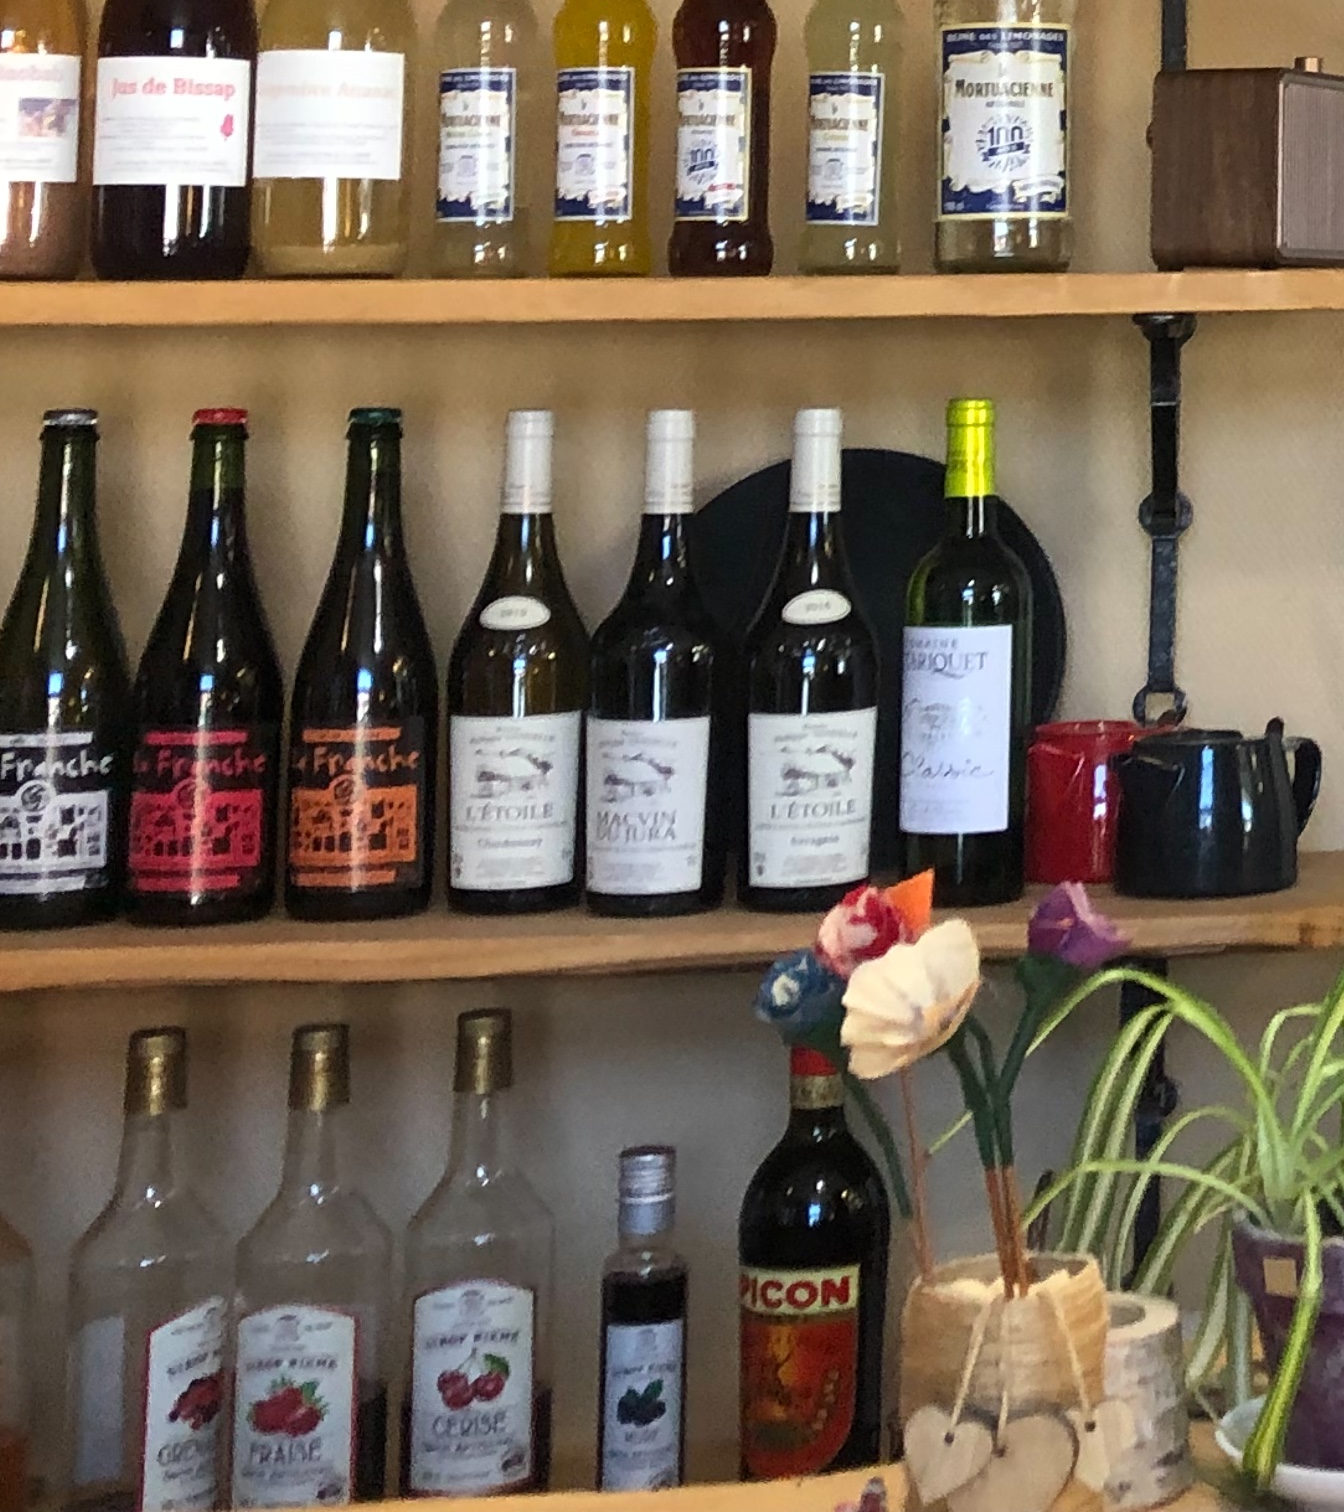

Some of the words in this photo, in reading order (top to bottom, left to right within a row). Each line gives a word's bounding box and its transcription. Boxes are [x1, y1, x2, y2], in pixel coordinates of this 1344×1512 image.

[142, 77, 168, 96] de
[172, 78, 237, 100] Bissap
[1, 750, 114, 782] Franche
[157, 747, 267, 779] Franche
[313, 744, 420, 776] Franche
[739, 1274, 852, 1310] PICON
[432, 1411, 508, 1438] CERISE
[250, 1438, 322, 1465] FRAISE
